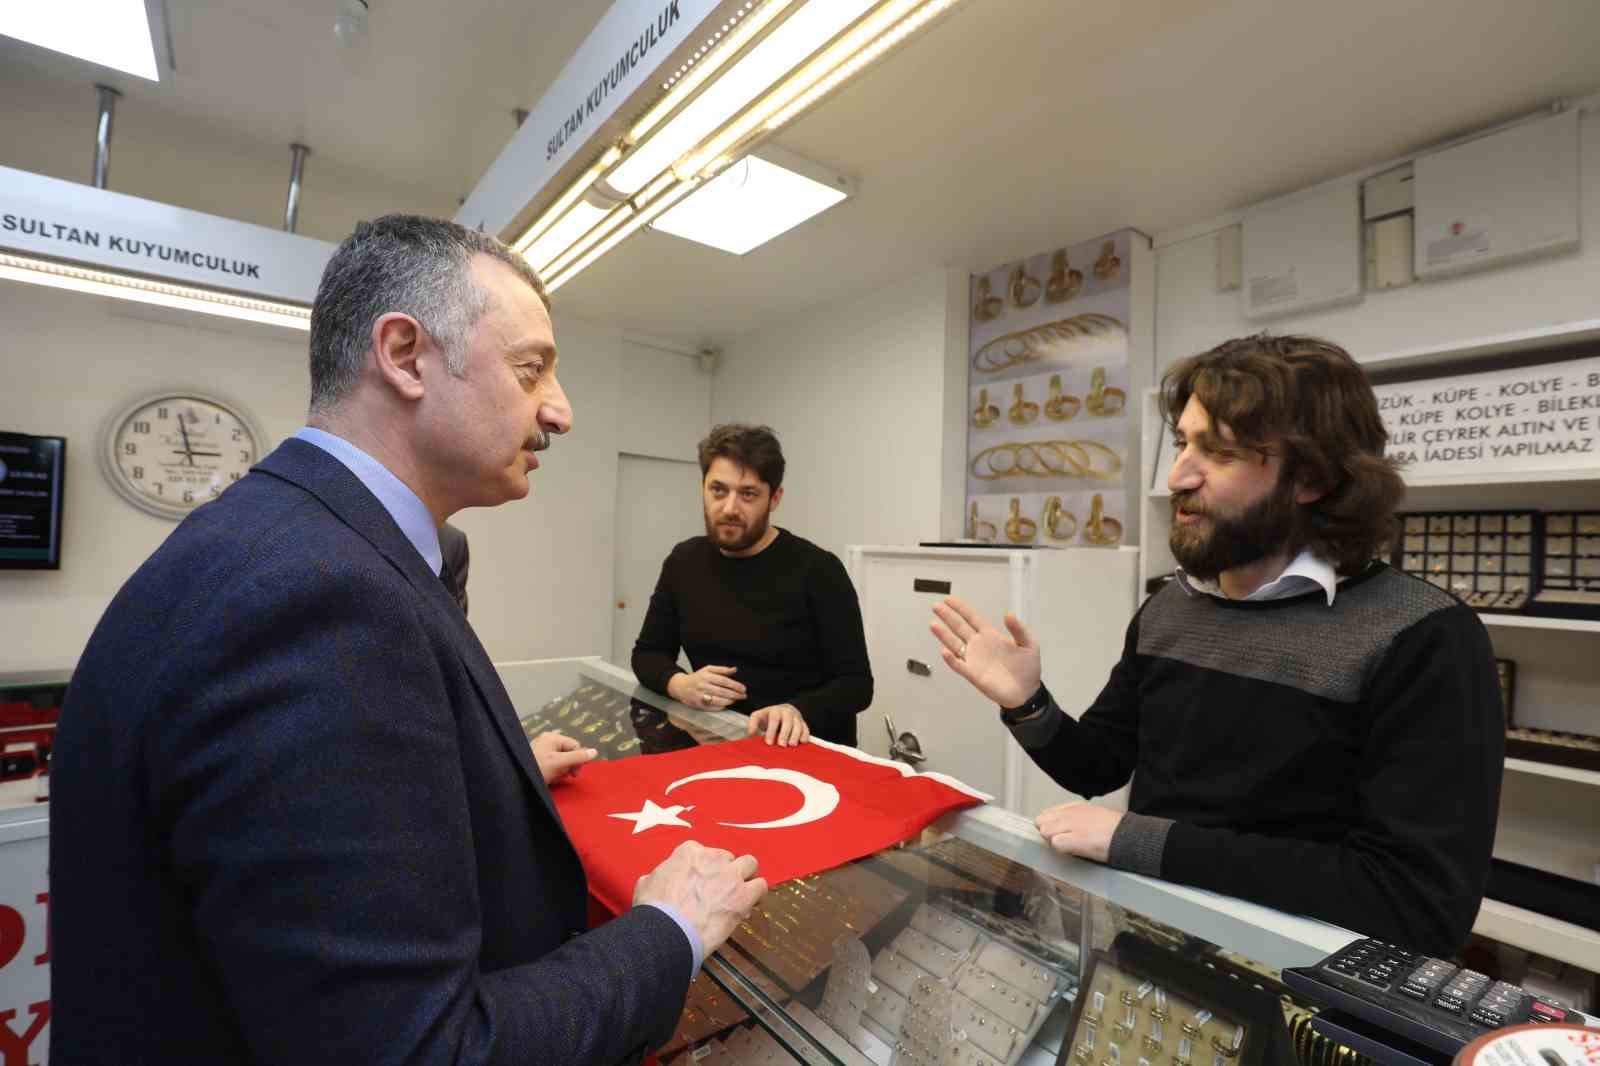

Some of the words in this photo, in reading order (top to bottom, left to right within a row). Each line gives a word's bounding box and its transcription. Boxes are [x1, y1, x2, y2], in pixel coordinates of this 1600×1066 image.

[547, 104, 584, 161] SULTAN
[586, 0, 680, 118] KUYUMCULUK
[2, 214, 100, 247] SULTAN
[108, 235, 260, 279] KUYUMCULUK
[1432, 386, 1479, 404] KÜPE
[1499, 377, 1563, 397] KOLYE
[1400, 410, 1444, 425] KÜPE
[1456, 402, 1515, 421] KOLYE
[1422, 425, 1490, 446] ÇEYREK
[1497, 421, 1555, 437] ALTIN
[1563, 416, 1590, 431] VE
[1424, 445, 1484, 462] İADESİ
[1490, 438, 1594, 457] YAPILMAZ
